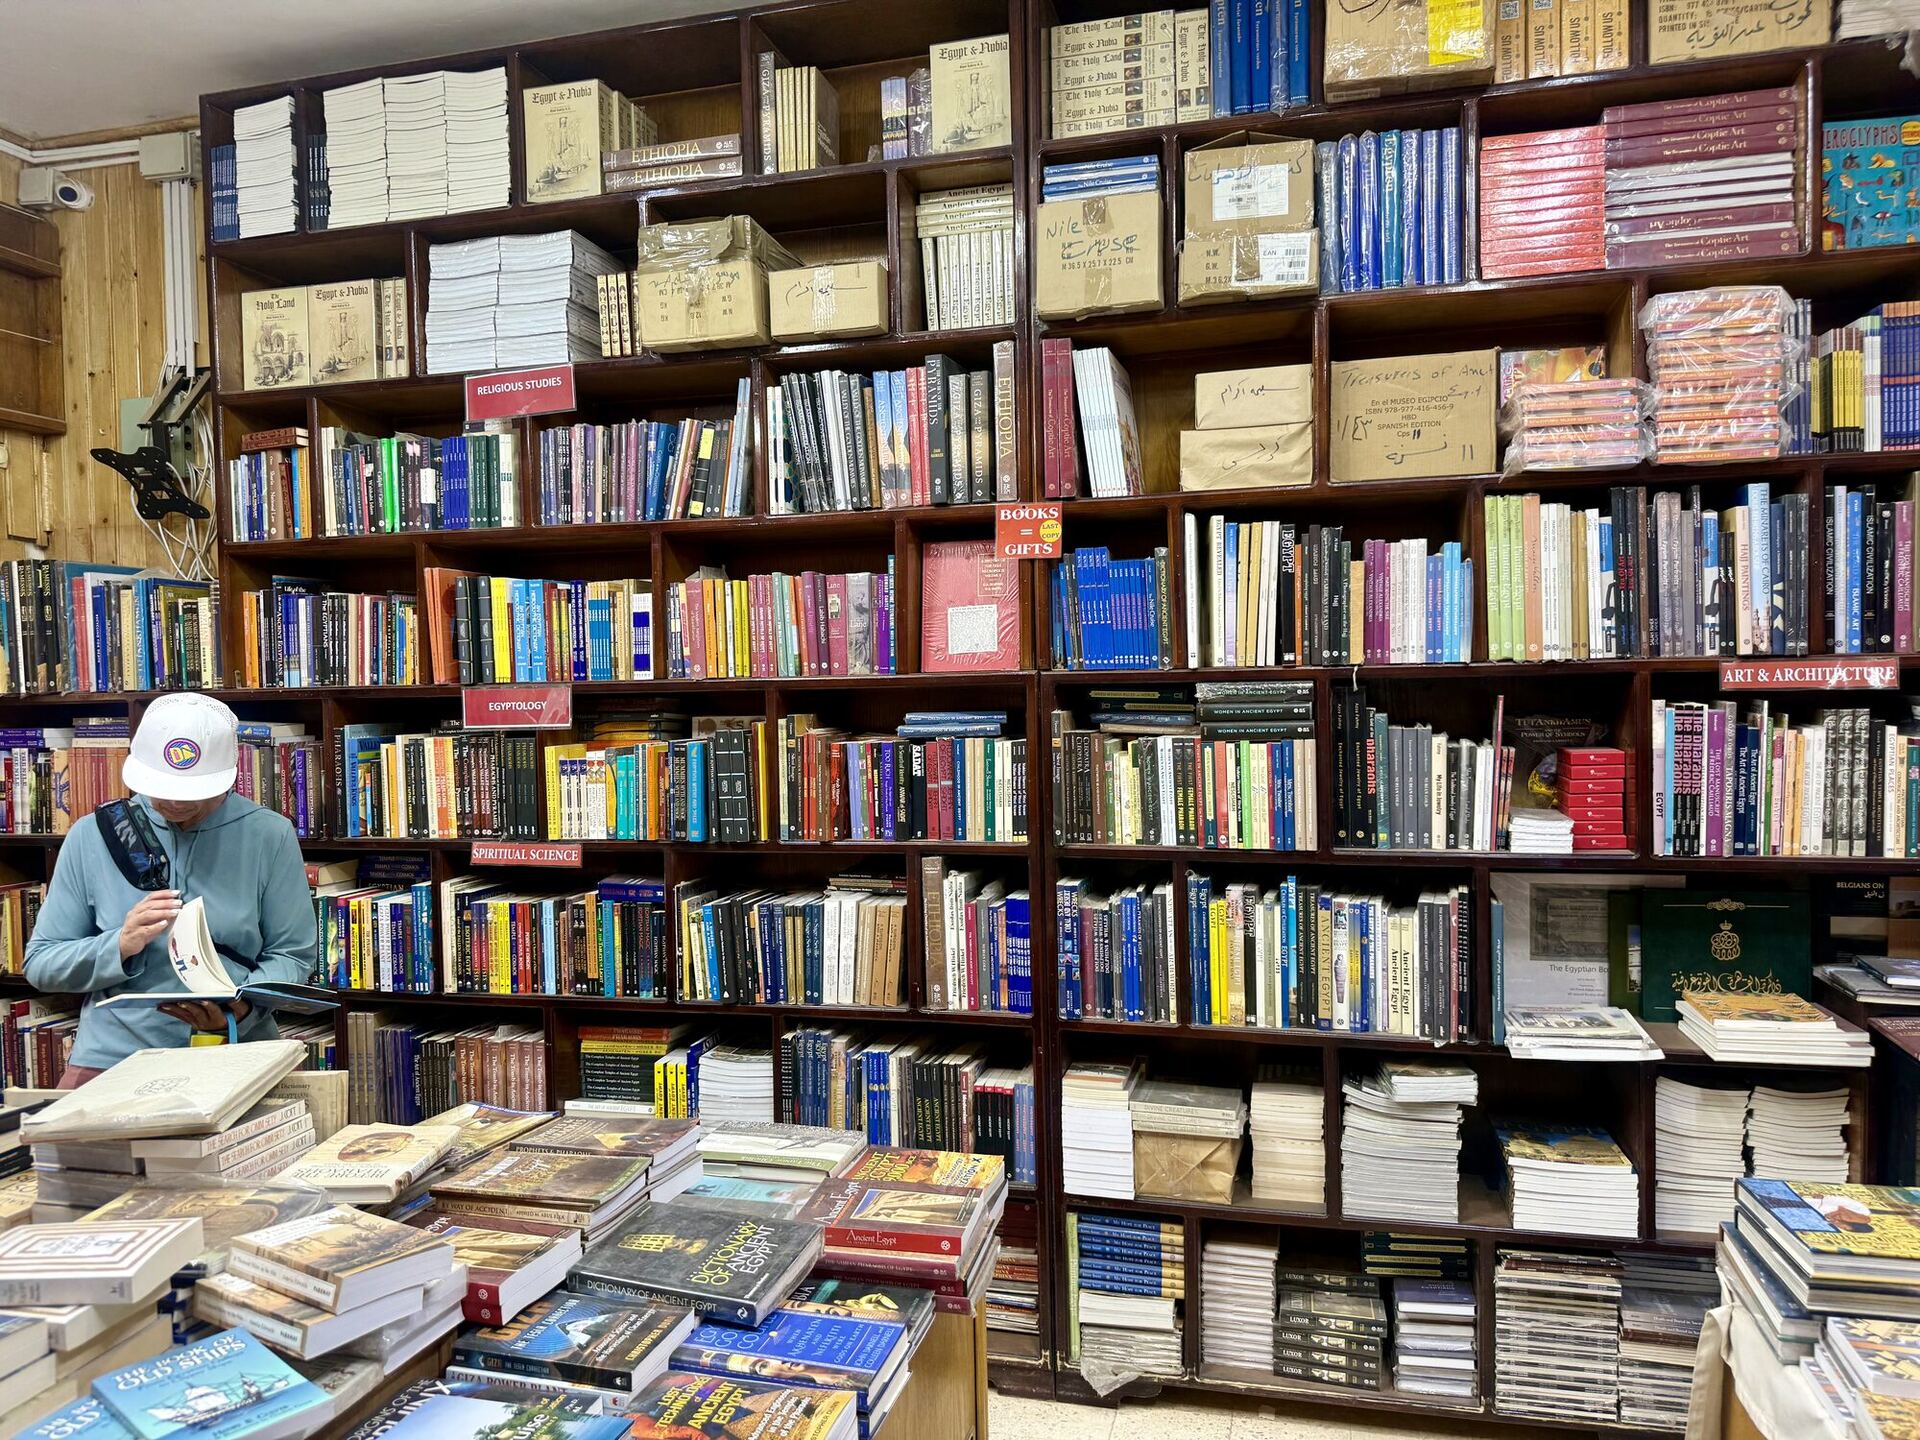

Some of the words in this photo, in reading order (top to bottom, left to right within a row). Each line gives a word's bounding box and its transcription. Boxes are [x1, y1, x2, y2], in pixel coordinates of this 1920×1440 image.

[1570, 16, 1580, 27] US
[1602, 11, 1613, 22] US
[1659, 24, 1686, 32] PRINTED
[939, 46, 968, 60] Egypt
[970, 46, 977, 55] &
[978, 40, 1008, 55] Nubia
[1501, 35, 1512, 44] US
[1571, 29, 1580, 62] FOLLOW
[1602, 24, 1613, 58] FOLLOW
[1502, 48, 1512, 80] FOLLOW
[532, 91, 556, 105] Egypt
[559, 92, 566, 100] &
[566, 86, 592, 99] Nubia
[632, 142, 701, 163] ETHIOPIA
[635, 163, 704, 184] ETHIOPIA
[1046, 216, 1081, 240] Nile
[1700, 235, 1733, 247] Coptic
[1735, 233, 1749, 243] Art
[1701, 249, 1733, 259] Coptic
[1735, 246, 1749, 256] Art
[315, 288, 338, 300] Egypt
[339, 289, 345, 297] &
[347, 286, 369, 297] Nubia
[256, 300, 275, 311] Holy
[276, 299, 296, 308] Land
[477, 379, 524, 396] RELIGIOUS
[525, 376, 562, 390] STUDIES
[927, 360, 938, 425] PYRAMIDS
[974, 389, 982, 416] GIZA
[999, 377, 1013, 458] ETHIOPIA
[1377, 422, 1409, 430] SPANISH
[1411, 420, 1441, 429] EDITION
[1000, 508, 1059, 520] BOOKS
[1761, 508, 1769, 552] MINARETS
[1866, 515, 1874, 545] ISLAMIC
[1005, 543, 1053, 555] GIFTS
[1282, 529, 1295, 573] EGYPT
[1762, 567, 1770, 594] CAIRO
[1866, 546, 1874, 594] CIVILIZATION
[1742, 564, 1750, 612] PAINTINGS
[1724, 669, 1754, 682] ART
[1757, 669, 1769, 681] &
[1773, 666, 1896, 681] ARCHITECTURE
[489, 701, 547, 711] EGYPTOLOGY
[334, 734, 342, 787] PHARAOHS
[913, 745, 921, 776] SADAT
[1366, 738, 1376, 795] pharaohs
[1692, 735, 1702, 795] pharaohs
[1656, 792, 1664, 819] EGYPT
[472, 848, 527, 859] SPIRITIUAL
[530, 851, 579, 862] SCIENCE
[1836, 882, 1867, 890] BELGIANS
[1321, 916, 1329, 971] ANCIENT
[1549, 964, 1563, 973] The
[1565, 964, 1597, 976] Egyptian
[1322, 977, 1330, 1011] EGYPT
[1391, 987, 1399, 1014] Egypt
[1402, 987, 1410, 1015] Egypt
[207, 1140, 217, 1150] THE
[217, 1134, 238, 1147] SEARCH
[238, 1128, 250, 1138] FOR
[846, 1230, 876, 1242] Ancient
[876, 1231, 897, 1245] Egypt
[690, 1221, 754, 1284] DICTIONARY
[711, 1268, 734, 1286] OF
[726, 1224, 776, 1272] ANCIENT
[740, 1241, 779, 1274] EGYPT
[587, 1280, 637, 1297] DICTIONARY
[637, 1290, 649, 1299] OF
[650, 1292, 689, 1308] ANCIENT
[691, 1300, 717, 1313] EGYPT
[1289, 1315, 1309, 1324] LUXOR
[213, 1334, 236, 1347] OF
[1282, 1332, 1302, 1341] LUXOR
[116, 1365, 173, 1391] OLD
[178, 1339, 247, 1371] SHIPS
[1282, 1349, 1302, 1358] LUXOR
[1282, 1365, 1303, 1374] LUXOR
[392, 1392, 412, 1409] OF
[660, 1386, 684, 1406] LOST
[688, 1381, 737, 1429] ANCIENT
[712, 1388, 751, 1424] EGYPT
[49, 1410, 100, 1440] OLD
